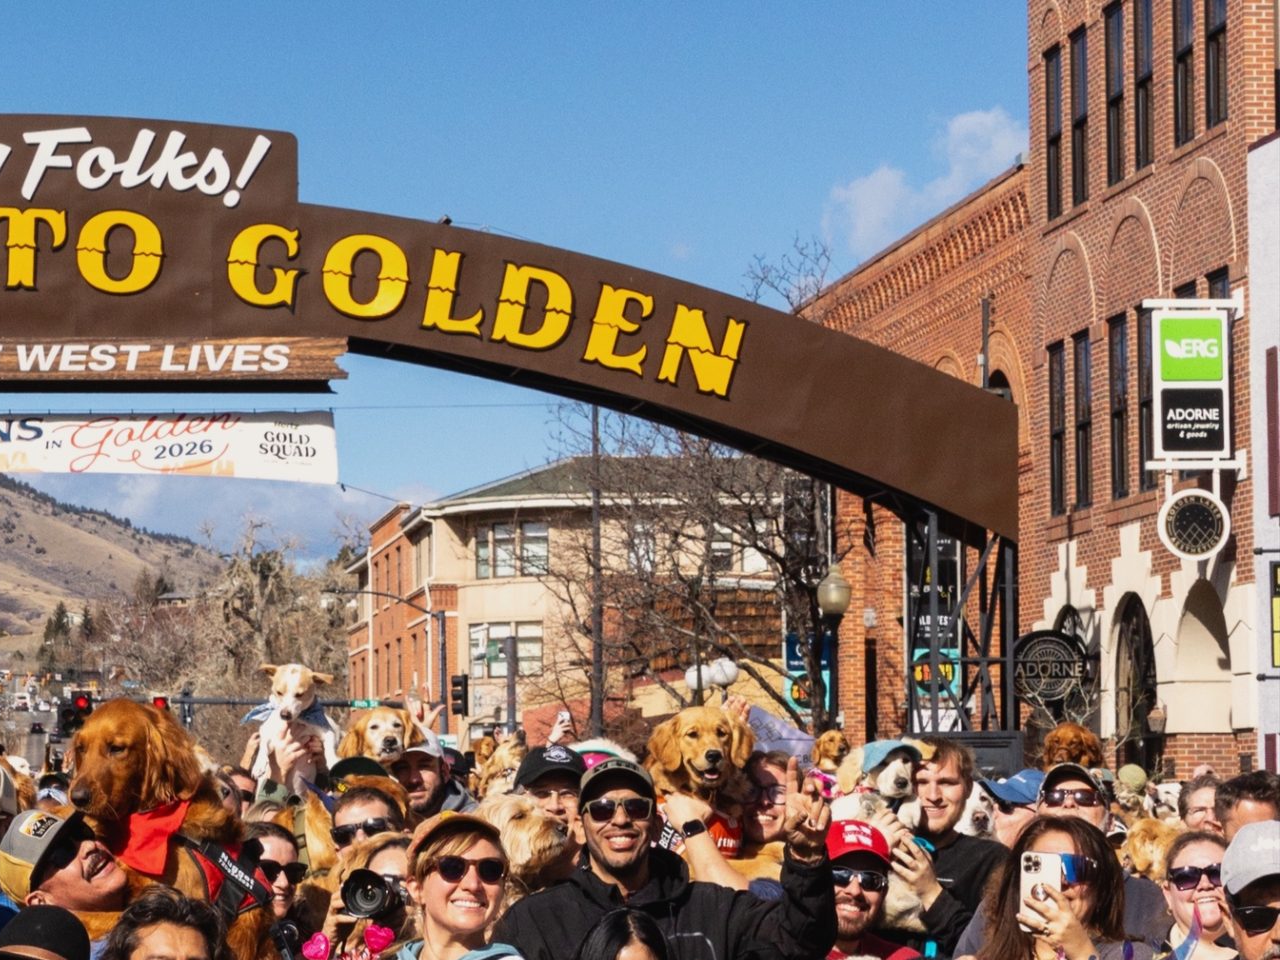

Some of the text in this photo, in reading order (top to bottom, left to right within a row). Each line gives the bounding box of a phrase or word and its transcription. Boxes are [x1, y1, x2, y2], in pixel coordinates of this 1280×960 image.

[22, 127, 271, 208] Folks!
[227, 223, 750, 399] GOLDEN
[1181, 338, 1219, 358] ERG
[16, 344, 150, 372] WEST
[160, 344, 290, 372] LIVES
[1166, 408, 1220, 421] ADORNE
[1166, 421, 1192, 430] artisan
[53, 411, 241, 474] Golden
[264, 431, 310, 444] GOLD
[1186, 430, 1208, 440] goods
[45, 440, 62, 450] IN
[154, 440, 214, 460] 2026
[259, 443, 317, 460] SQUAD
[1014, 662, 1083, 678] ADORNE
